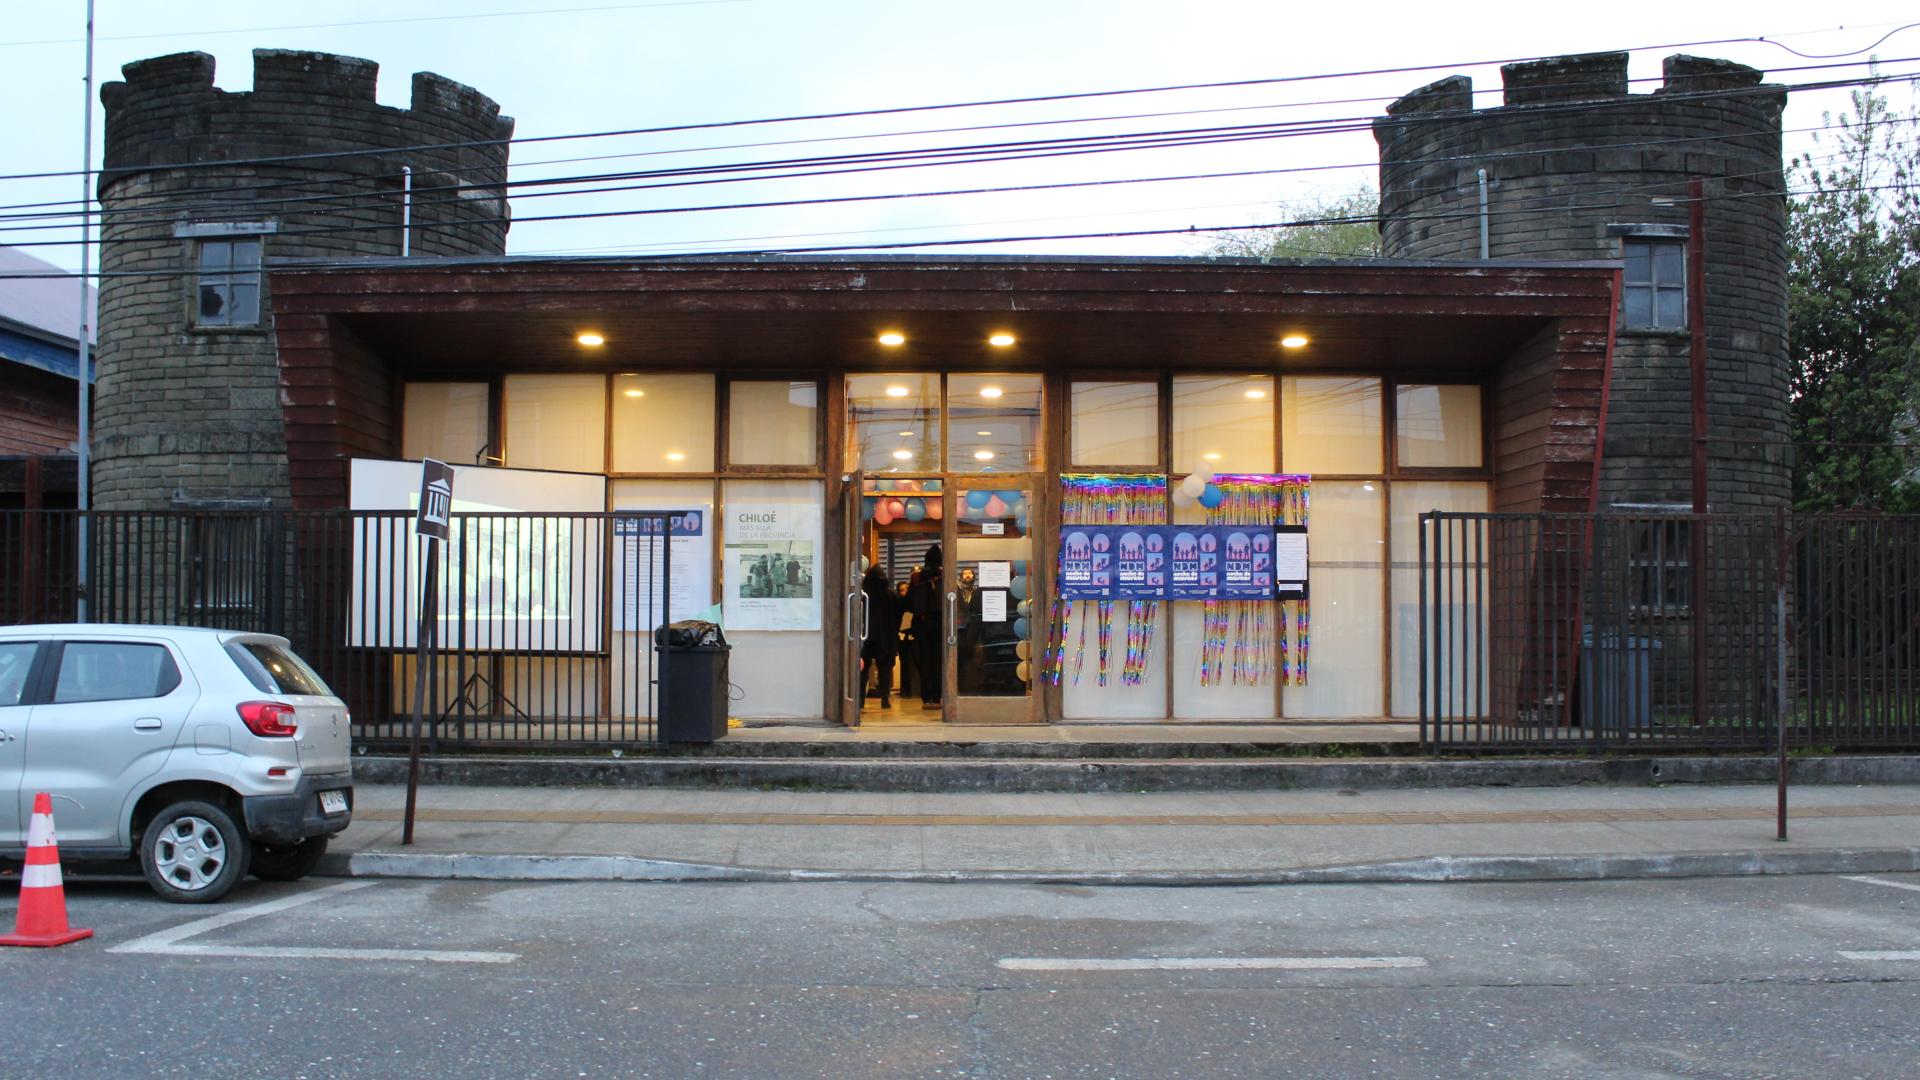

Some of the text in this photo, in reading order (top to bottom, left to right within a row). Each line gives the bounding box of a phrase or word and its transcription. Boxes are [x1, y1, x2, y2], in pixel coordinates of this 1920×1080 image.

[739, 510, 777, 523] CHILOÉ
[1065, 561, 1090, 572] NDM
[1119, 561, 1145, 572] NDM
[1172, 561, 1198, 572] NDM
[1225, 561, 1252, 572] NDM
